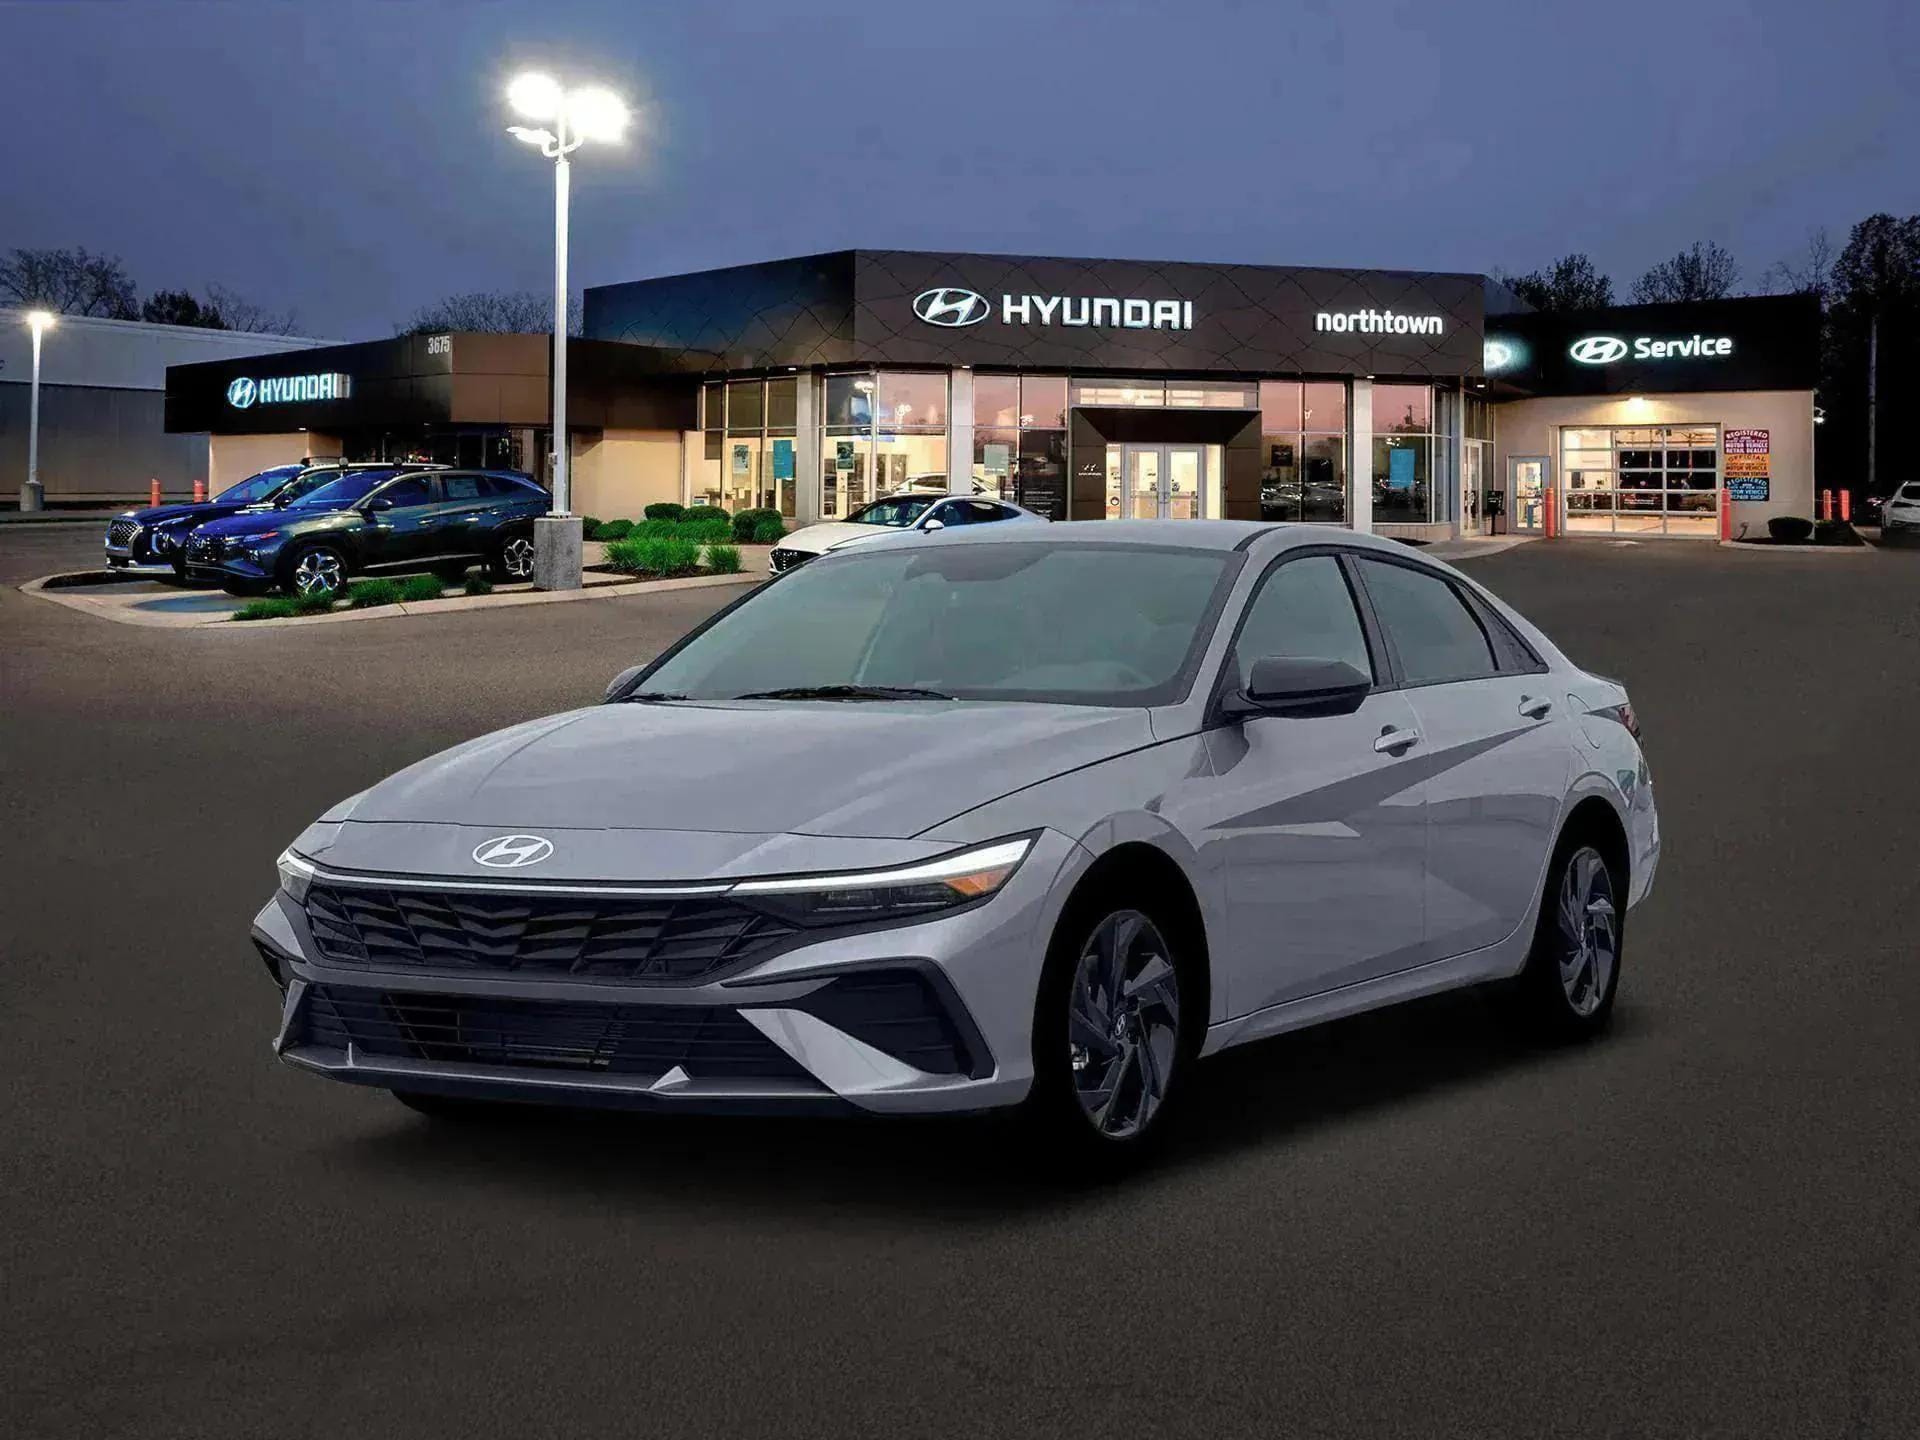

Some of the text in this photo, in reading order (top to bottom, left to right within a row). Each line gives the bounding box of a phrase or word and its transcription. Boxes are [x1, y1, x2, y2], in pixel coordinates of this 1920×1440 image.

[1002, 294, 1192, 330] HYUNDAI
[1317, 309, 1443, 334] northtown
[428, 335, 450, 354] 3675
[1634, 335, 1733, 359] Service
[259, 373, 350, 403] HYUNDAI
[1726, 430, 1768, 439] REGISTERED
[1728, 454, 1765, 462] OFFICIAL
[1726, 477, 1767, 486] REGISTERED
